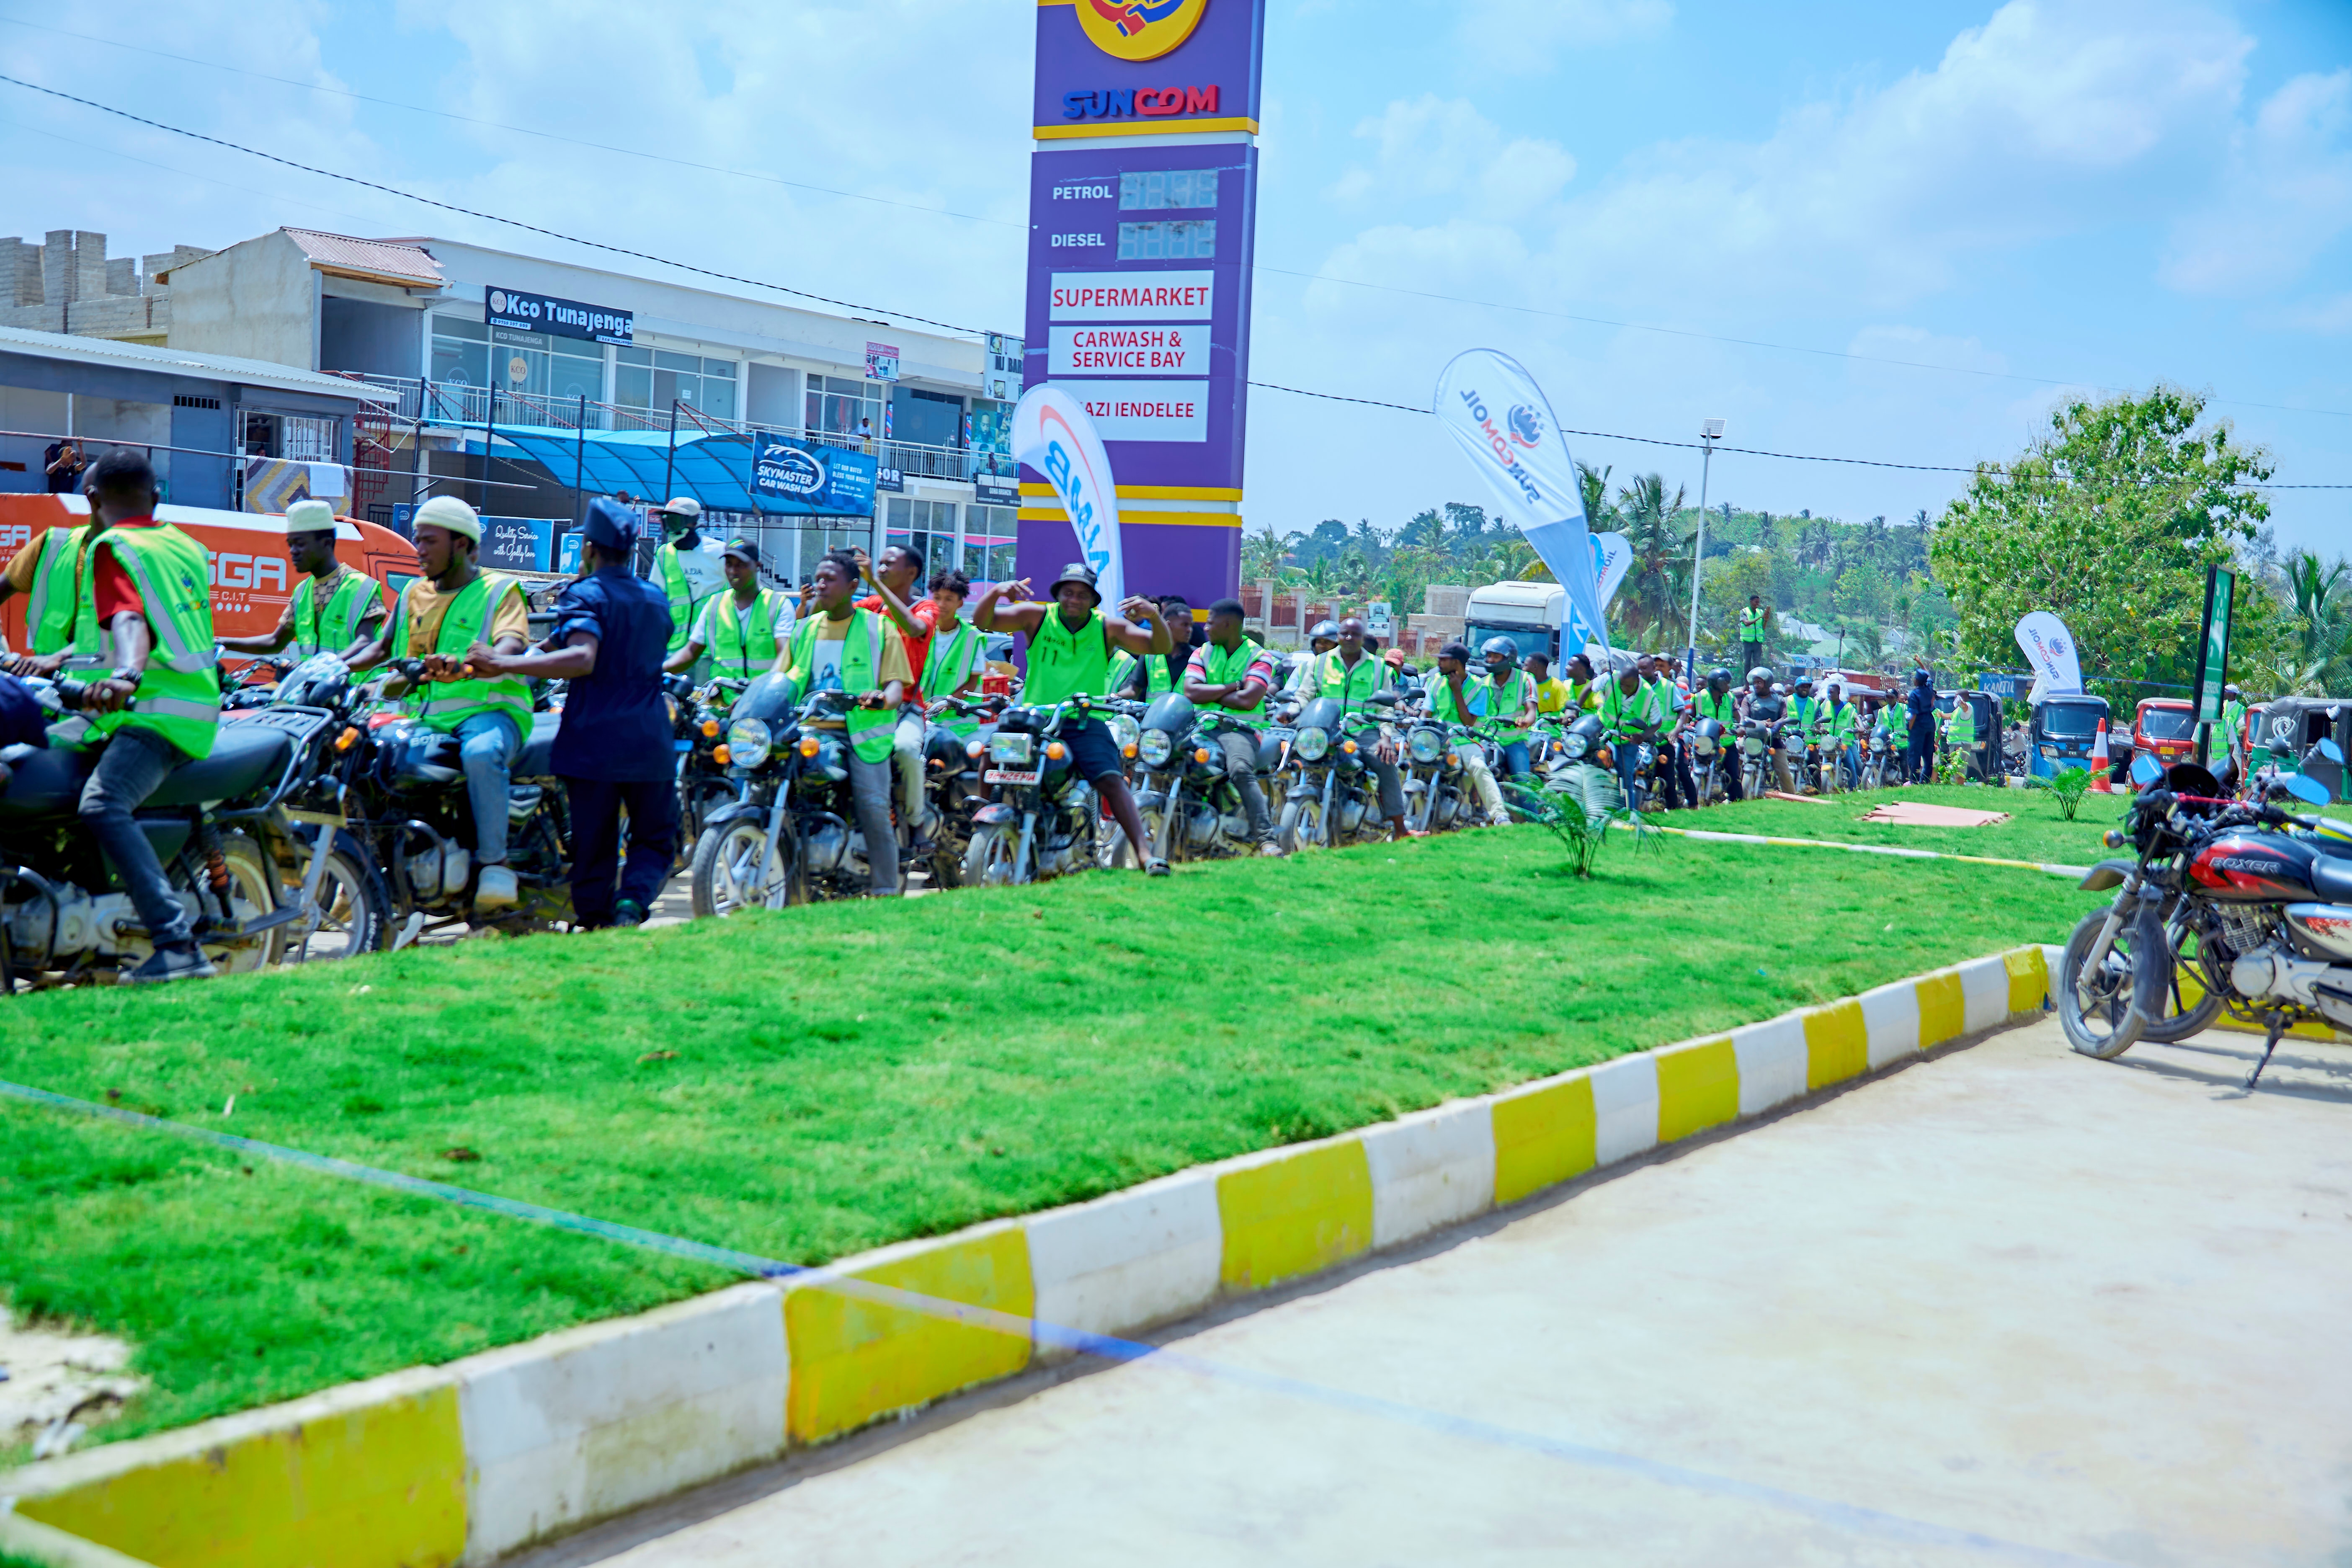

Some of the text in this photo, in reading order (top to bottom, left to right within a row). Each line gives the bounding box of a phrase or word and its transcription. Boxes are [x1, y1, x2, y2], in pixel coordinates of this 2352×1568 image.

[1063, 85, 1218, 118] SUNCOM
[1053, 186, 1113, 199] PETROL
[1051, 234, 1105, 247] DIESEL
[1053, 287, 1208, 307] SUPERMARKET
[507, 294, 633, 336] Kco Tunajenga
[508, 333, 543, 345] TUNAJENGA
[1073, 331, 1182, 347] CARWASH &
[1008, 357, 1023, 374] BAR
[1073, 352, 1185, 367] SERVICE BAY
[1081, 402, 1194, 417] AZI IENDELEE
[757, 465, 813, 485] SKYMASTER
[759, 478, 802, 493] CAR WASH
[495, 525, 539, 544] Quality Service
[493, 543, 536, 563] with Godly love
[209, 551, 287, 591] GA
[222, 591, 246, 602] C.I.T
[1042, 646, 1057, 666] 11
[2209, 856, 2281, 876] BOXER
